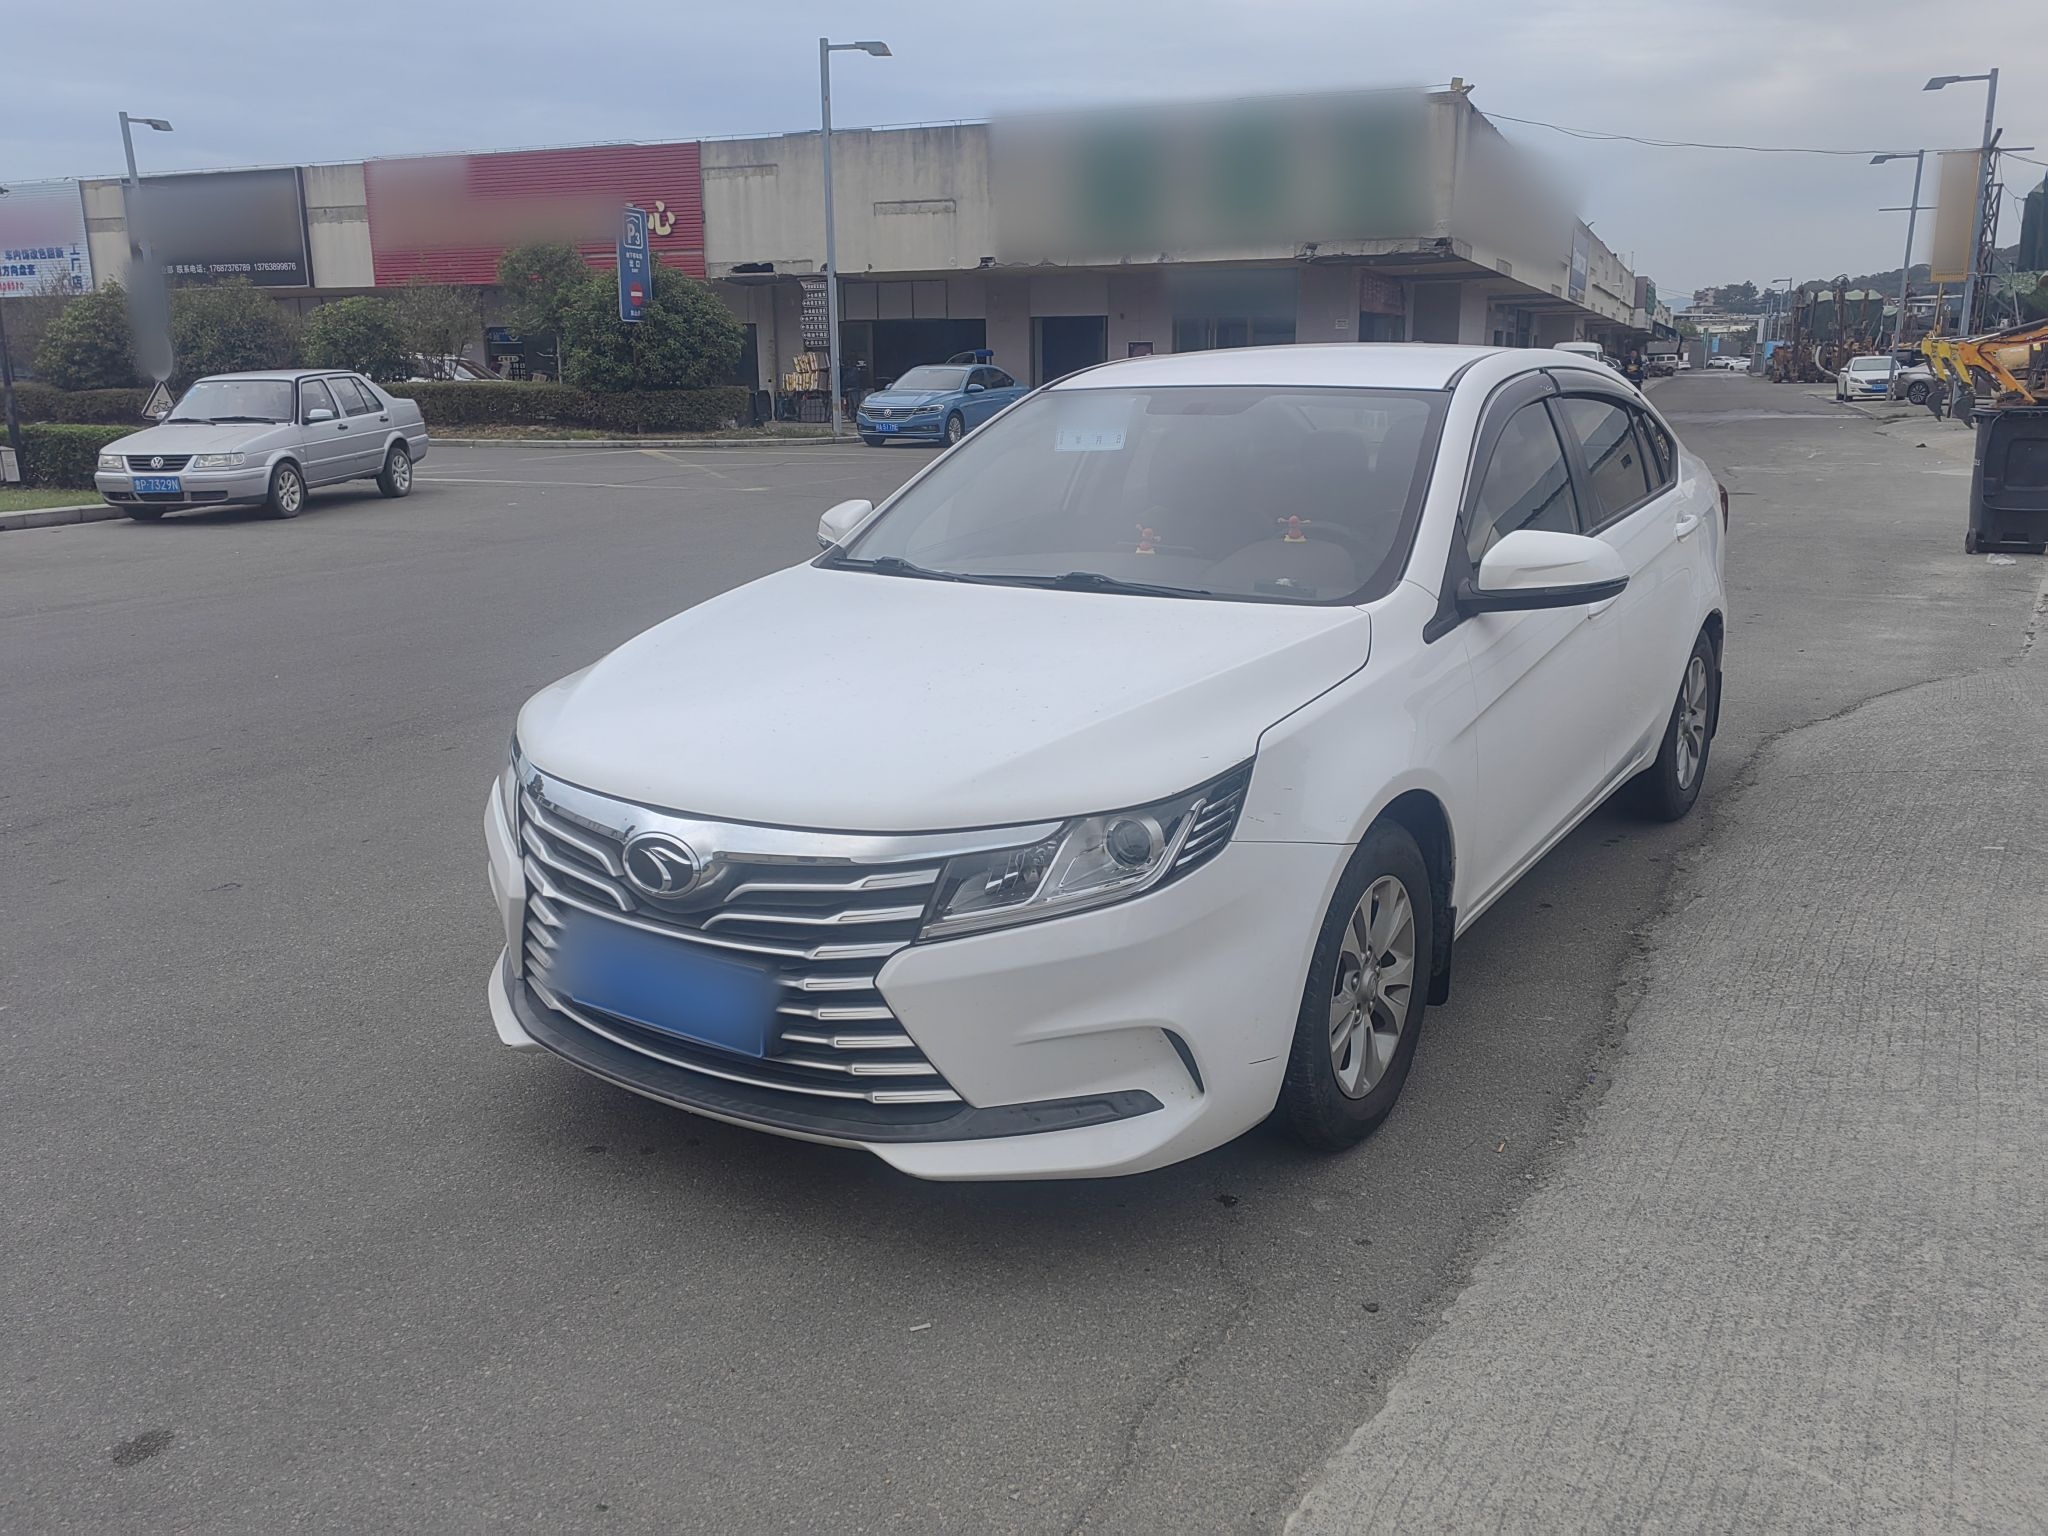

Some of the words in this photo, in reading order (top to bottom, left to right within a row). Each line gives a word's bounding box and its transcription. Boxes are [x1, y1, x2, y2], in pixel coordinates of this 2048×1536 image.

[648, 201, 675, 235] 心
[0, 264, 35, 277] 方向盘套
